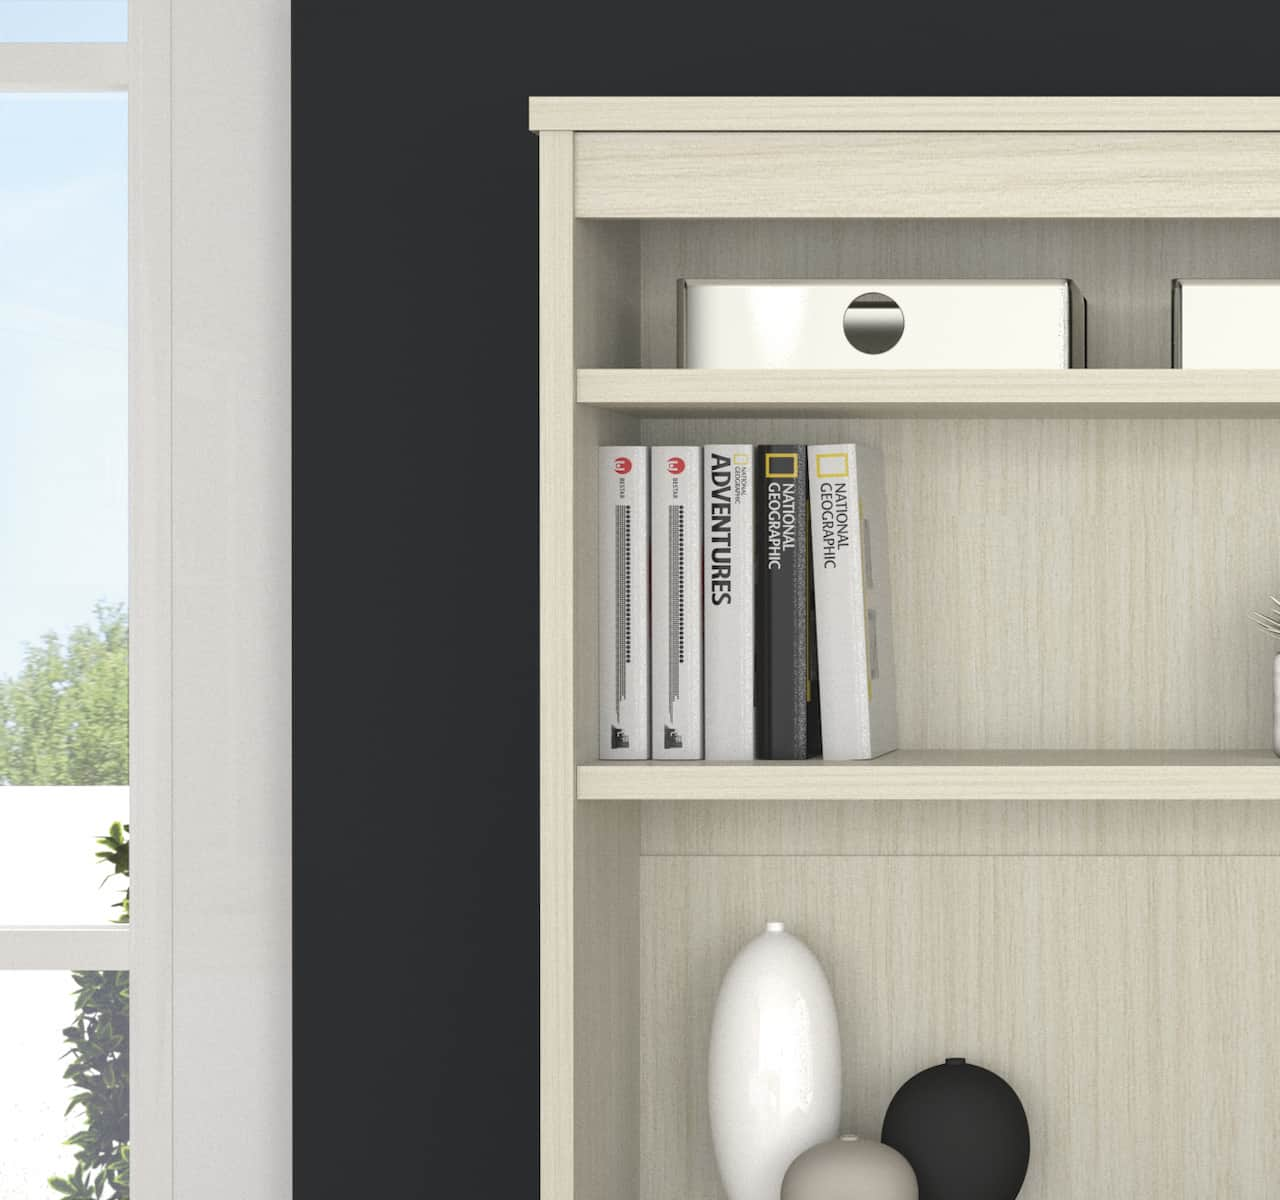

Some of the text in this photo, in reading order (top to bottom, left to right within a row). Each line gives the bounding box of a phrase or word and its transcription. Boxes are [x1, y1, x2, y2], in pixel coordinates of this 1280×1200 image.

[711, 453, 731, 606] ADVENTURES
[767, 482, 781, 570] GEOGRAPHIC
[782, 483, 796, 551] NATIONAL
[820, 482, 836, 569] GEOGRAPHIC
[834, 483, 849, 551] NATIONAL
